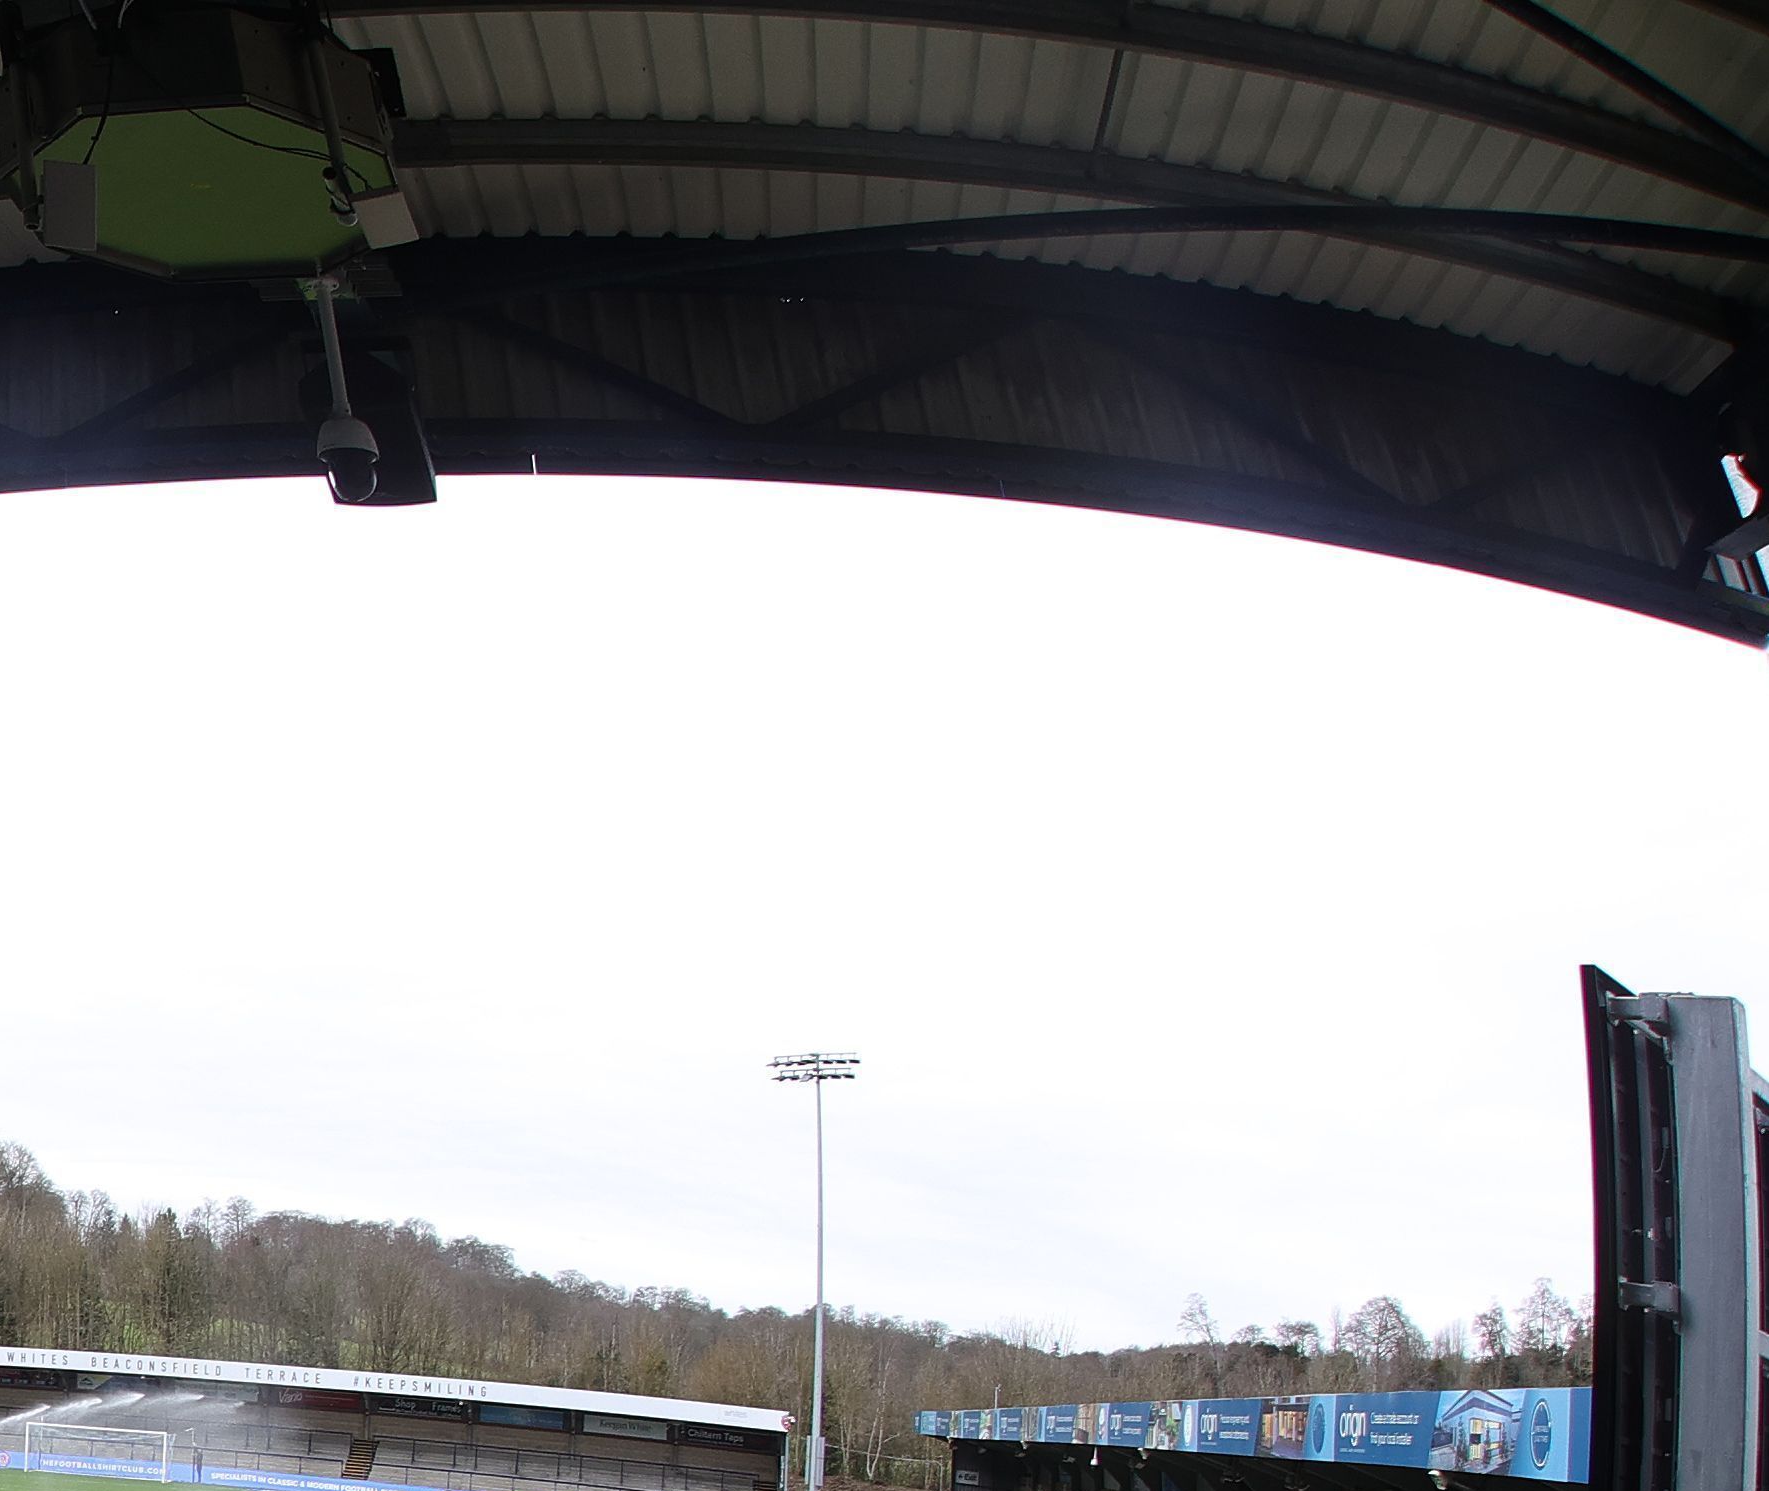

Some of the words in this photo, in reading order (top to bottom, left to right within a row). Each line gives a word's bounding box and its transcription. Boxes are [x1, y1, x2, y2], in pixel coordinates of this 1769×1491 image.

[7, 1352, 68, 1365] WHITES
[91, 1357, 221, 1376] BEACONSFIELD
[245, 1367, 321, 1384] TERRACE
[353, 1376, 486, 1397] #KEEPSMILING
[394, 1399, 416, 1409] Shop
[687, 1429, 722, 1440] Chiltern
[724, 1432, 744, 1443] Taps
[211, 1472, 256, 1482] SPECIALISTS
[258, 1474, 266, 1482] IN
[267, 1477, 298, 1487] CLASSIC
[307, 1480, 339, 1491] MODERN
